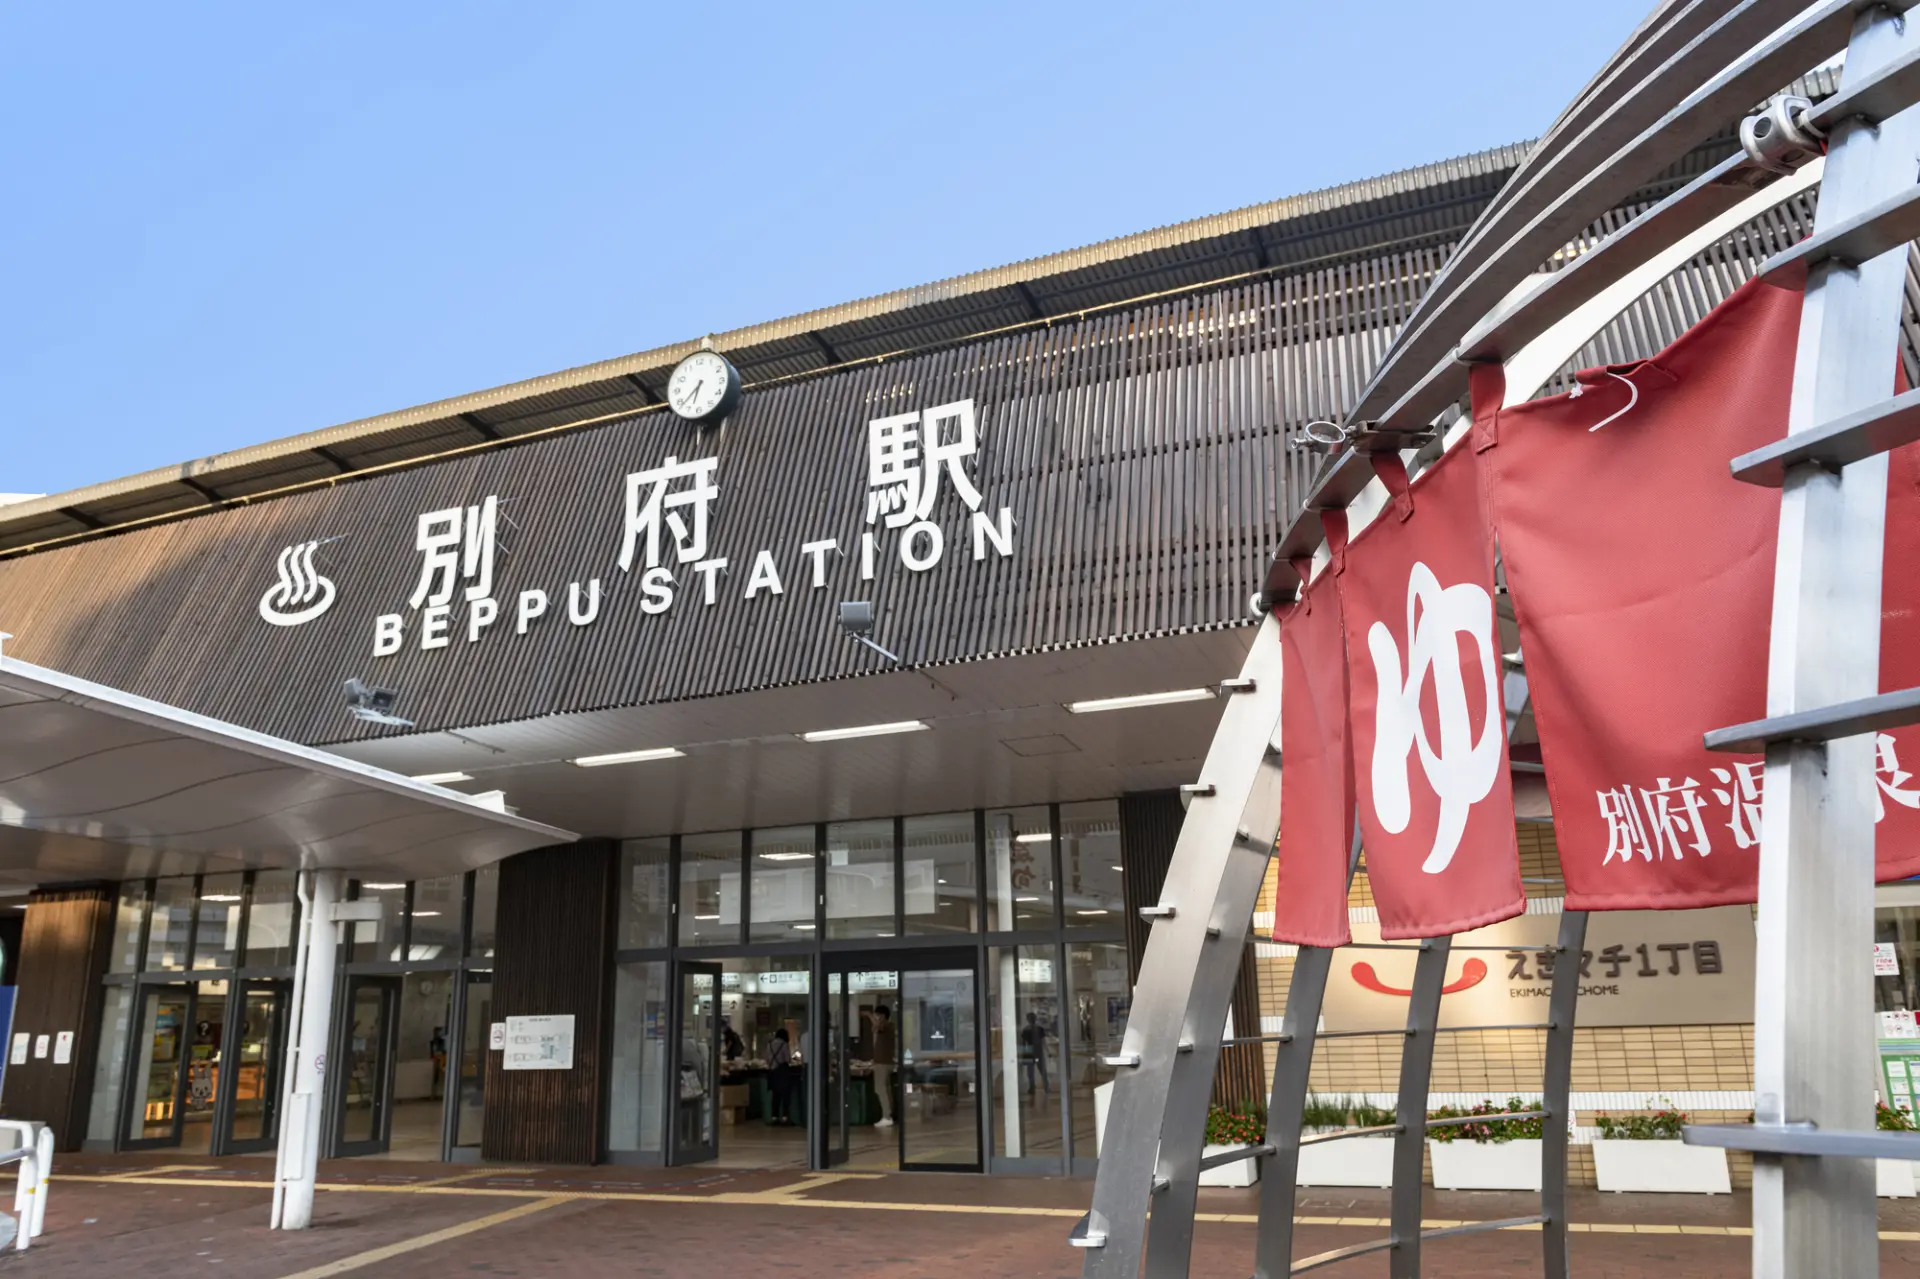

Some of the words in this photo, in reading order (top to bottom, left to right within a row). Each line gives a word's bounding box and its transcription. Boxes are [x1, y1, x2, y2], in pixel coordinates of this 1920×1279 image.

[695, 358, 704, 366] 12
[409, 399, 982, 609] 別府駅
[373, 578, 601, 657] BEPPU
[640, 506, 1014, 614] STATION
[1368, 561, 1502, 874] ゆ
[1509, 984, 1553, 998] EKIMAC
